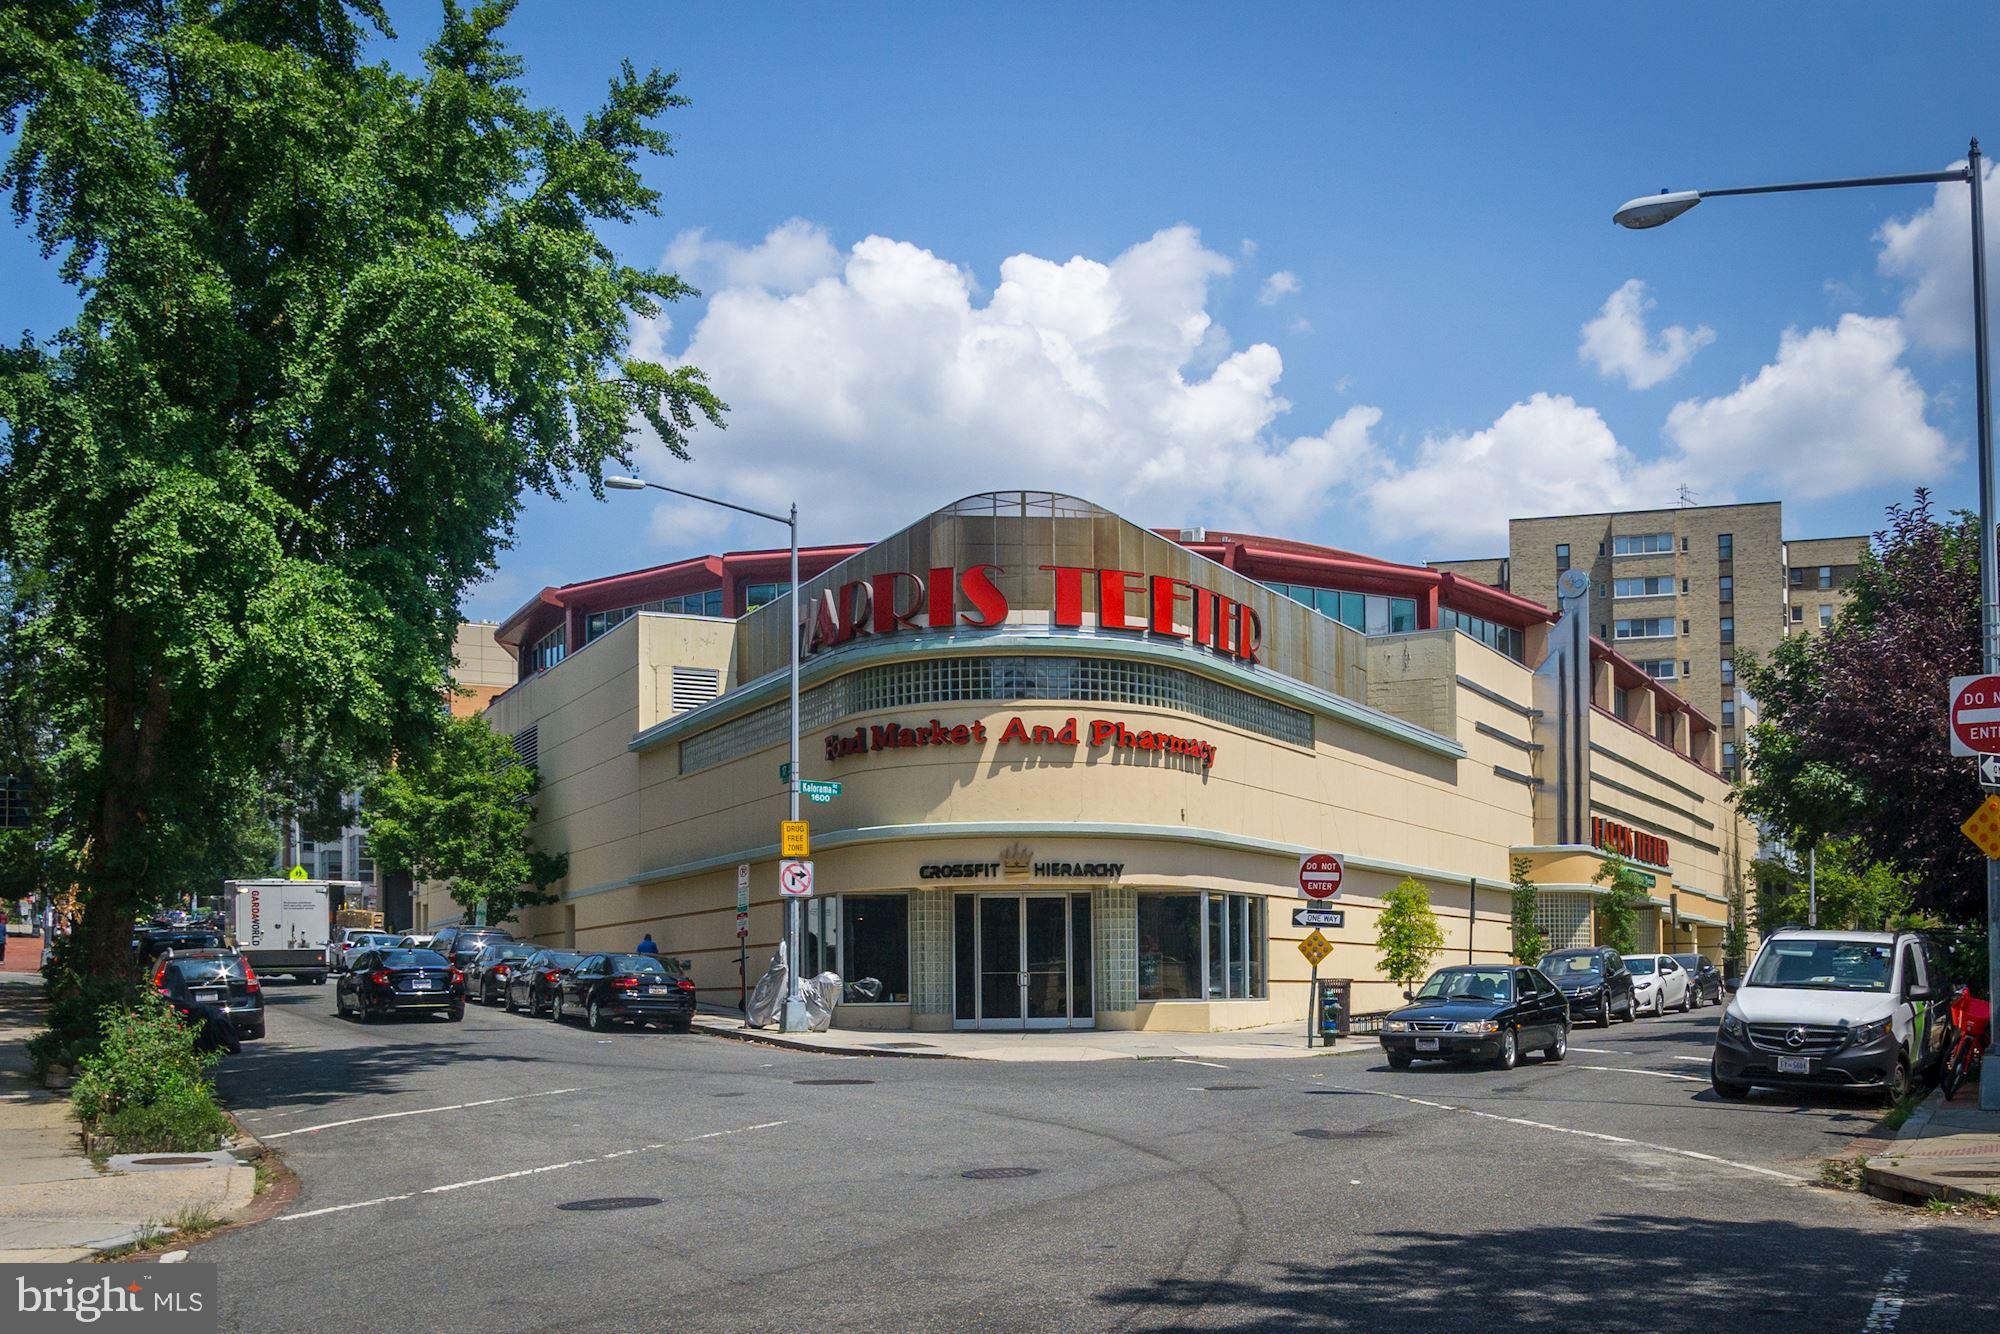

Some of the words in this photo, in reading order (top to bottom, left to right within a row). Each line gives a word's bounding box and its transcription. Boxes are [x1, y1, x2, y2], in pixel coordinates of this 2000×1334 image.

[1038, 564, 1261, 664] TEETER
[1964, 692, 1984, 706] DO
[1970, 726, 2000, 740] ENT
[870, 719, 987, 751] Market
[999, 717, 1079, 746] And
[1089, 719, 1218, 769] Pharmacy
[802, 782, 832, 794] Kalorama
[811, 793, 831, 802] 1600
[787, 844, 804, 852] ZONE
[919, 863, 1000, 879] CROSSFIT
[1034, 862, 1125, 878] HIERARCHY
[1306, 862, 1317, 870] DO
[1321, 862, 1336, 870] NOT
[1308, 882, 1332, 890] ENTER
[251, 890, 260, 946] GARDAWORLD
[1307, 914, 1321, 922] ONE
[1323, 914, 1339, 923] WAY
